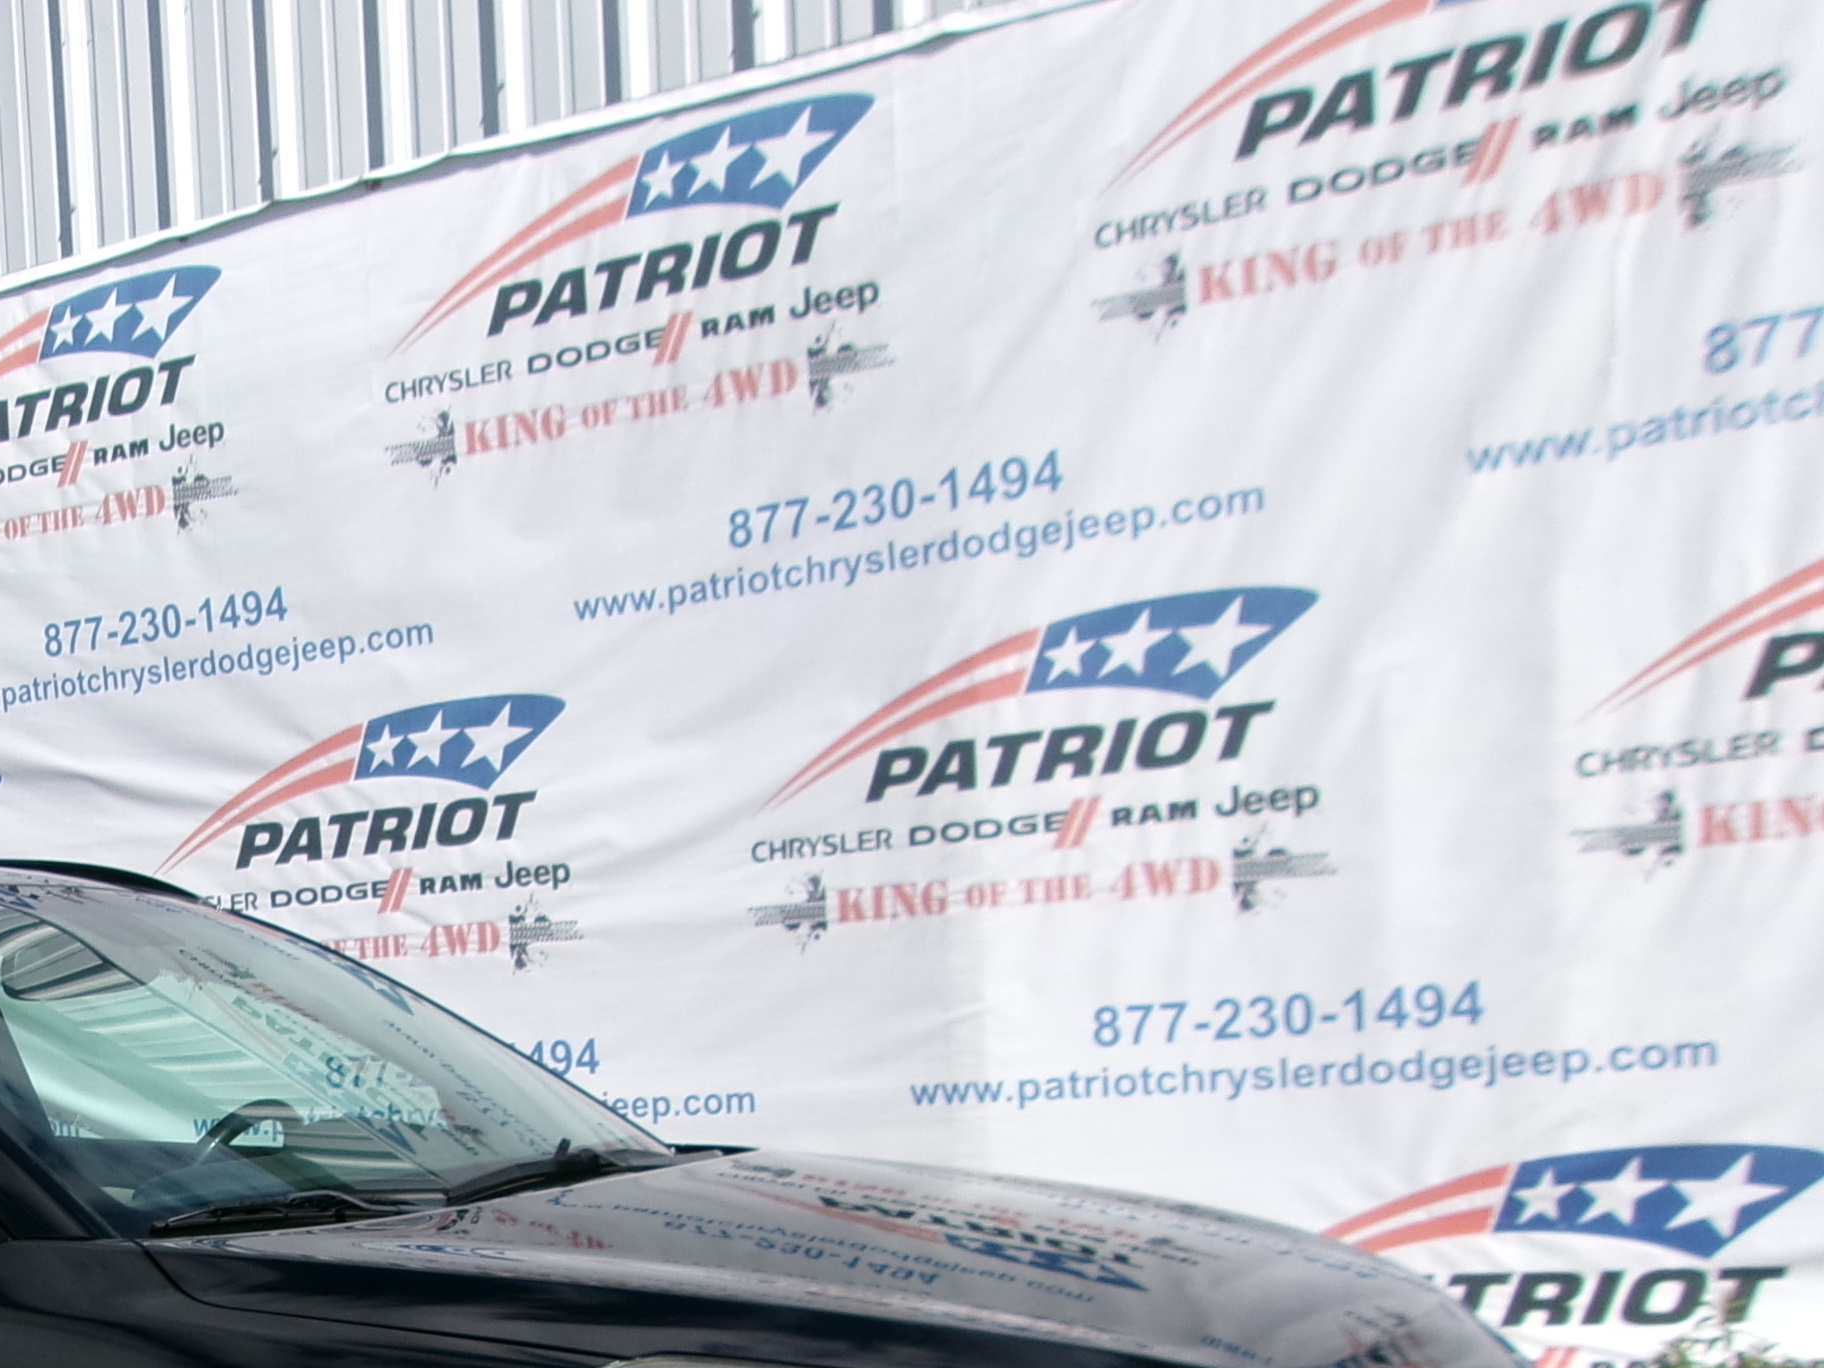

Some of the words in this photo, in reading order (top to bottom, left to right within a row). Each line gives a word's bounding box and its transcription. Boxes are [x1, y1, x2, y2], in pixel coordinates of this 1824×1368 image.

[1233, 0, 1709, 163] PATRIOT
[1094, 187, 1267, 250] CHRYSLER
[1287, 136, 1479, 206] DODGE
[1530, 101, 1643, 152] RAM
[1656, 66, 1789, 122] Jeep
[485, 202, 840, 339] PATRIOT
[1197, 240, 1338, 306] KING
[1357, 229, 1404, 268] OF
[1422, 208, 1507, 258] THE
[1528, 171, 1668, 238] 4WD
[384, 359, 514, 405] CHRYSLER
[526, 328, 664, 376] DODGE
[699, 305, 777, 340] RAM
[790, 278, 881, 322] Jeep
[93, 438, 149, 466] RAM
[159, 421, 225, 453] Jeep
[463, 403, 567, 458] KING
[581, 398, 622, 432] OF
[629, 385, 690, 420] THE
[702, 354, 800, 409] 4WD
[3, 517, 33, 542] OF
[36, 506, 86, 535] THE
[93, 484, 166, 527] 4WD
[727, 447, 1065, 551] 877-230-1494
[573, 484, 1265, 623] www.patriotchryslerdodgejeep.com
[44, 586, 288, 658] 877-230-1494
[864, 699, 1276, 804] PATRIOT
[1576, 730, 1781, 778] CHRYSLER
[234, 790, 537, 871] PATRIOT
[750, 828, 895, 863] CHRYSLER
[907, 811, 1067, 848] DODGE
[1110, 800, 1198, 828] RAM
[1214, 781, 1321, 818] Jeep
[1699, 796, 1824, 847] KIN
[270, 879, 391, 909] DODGE
[419, 872, 484, 897] RAM
[494, 858, 571, 893] Jeep
[836, 879, 949, 924] KING
[962, 882, 1002, 909] OF
[1017, 875, 1092, 905] THE
[1109, 856, 1222, 902] 4WD
[355, 934, 408, 961] THE
[419, 920, 501, 959] 4WD
[1092, 979, 1485, 1048] 877-230-1494
[909, 1039, 1720, 1109] www.patriotchryslerdodgejeep.com
